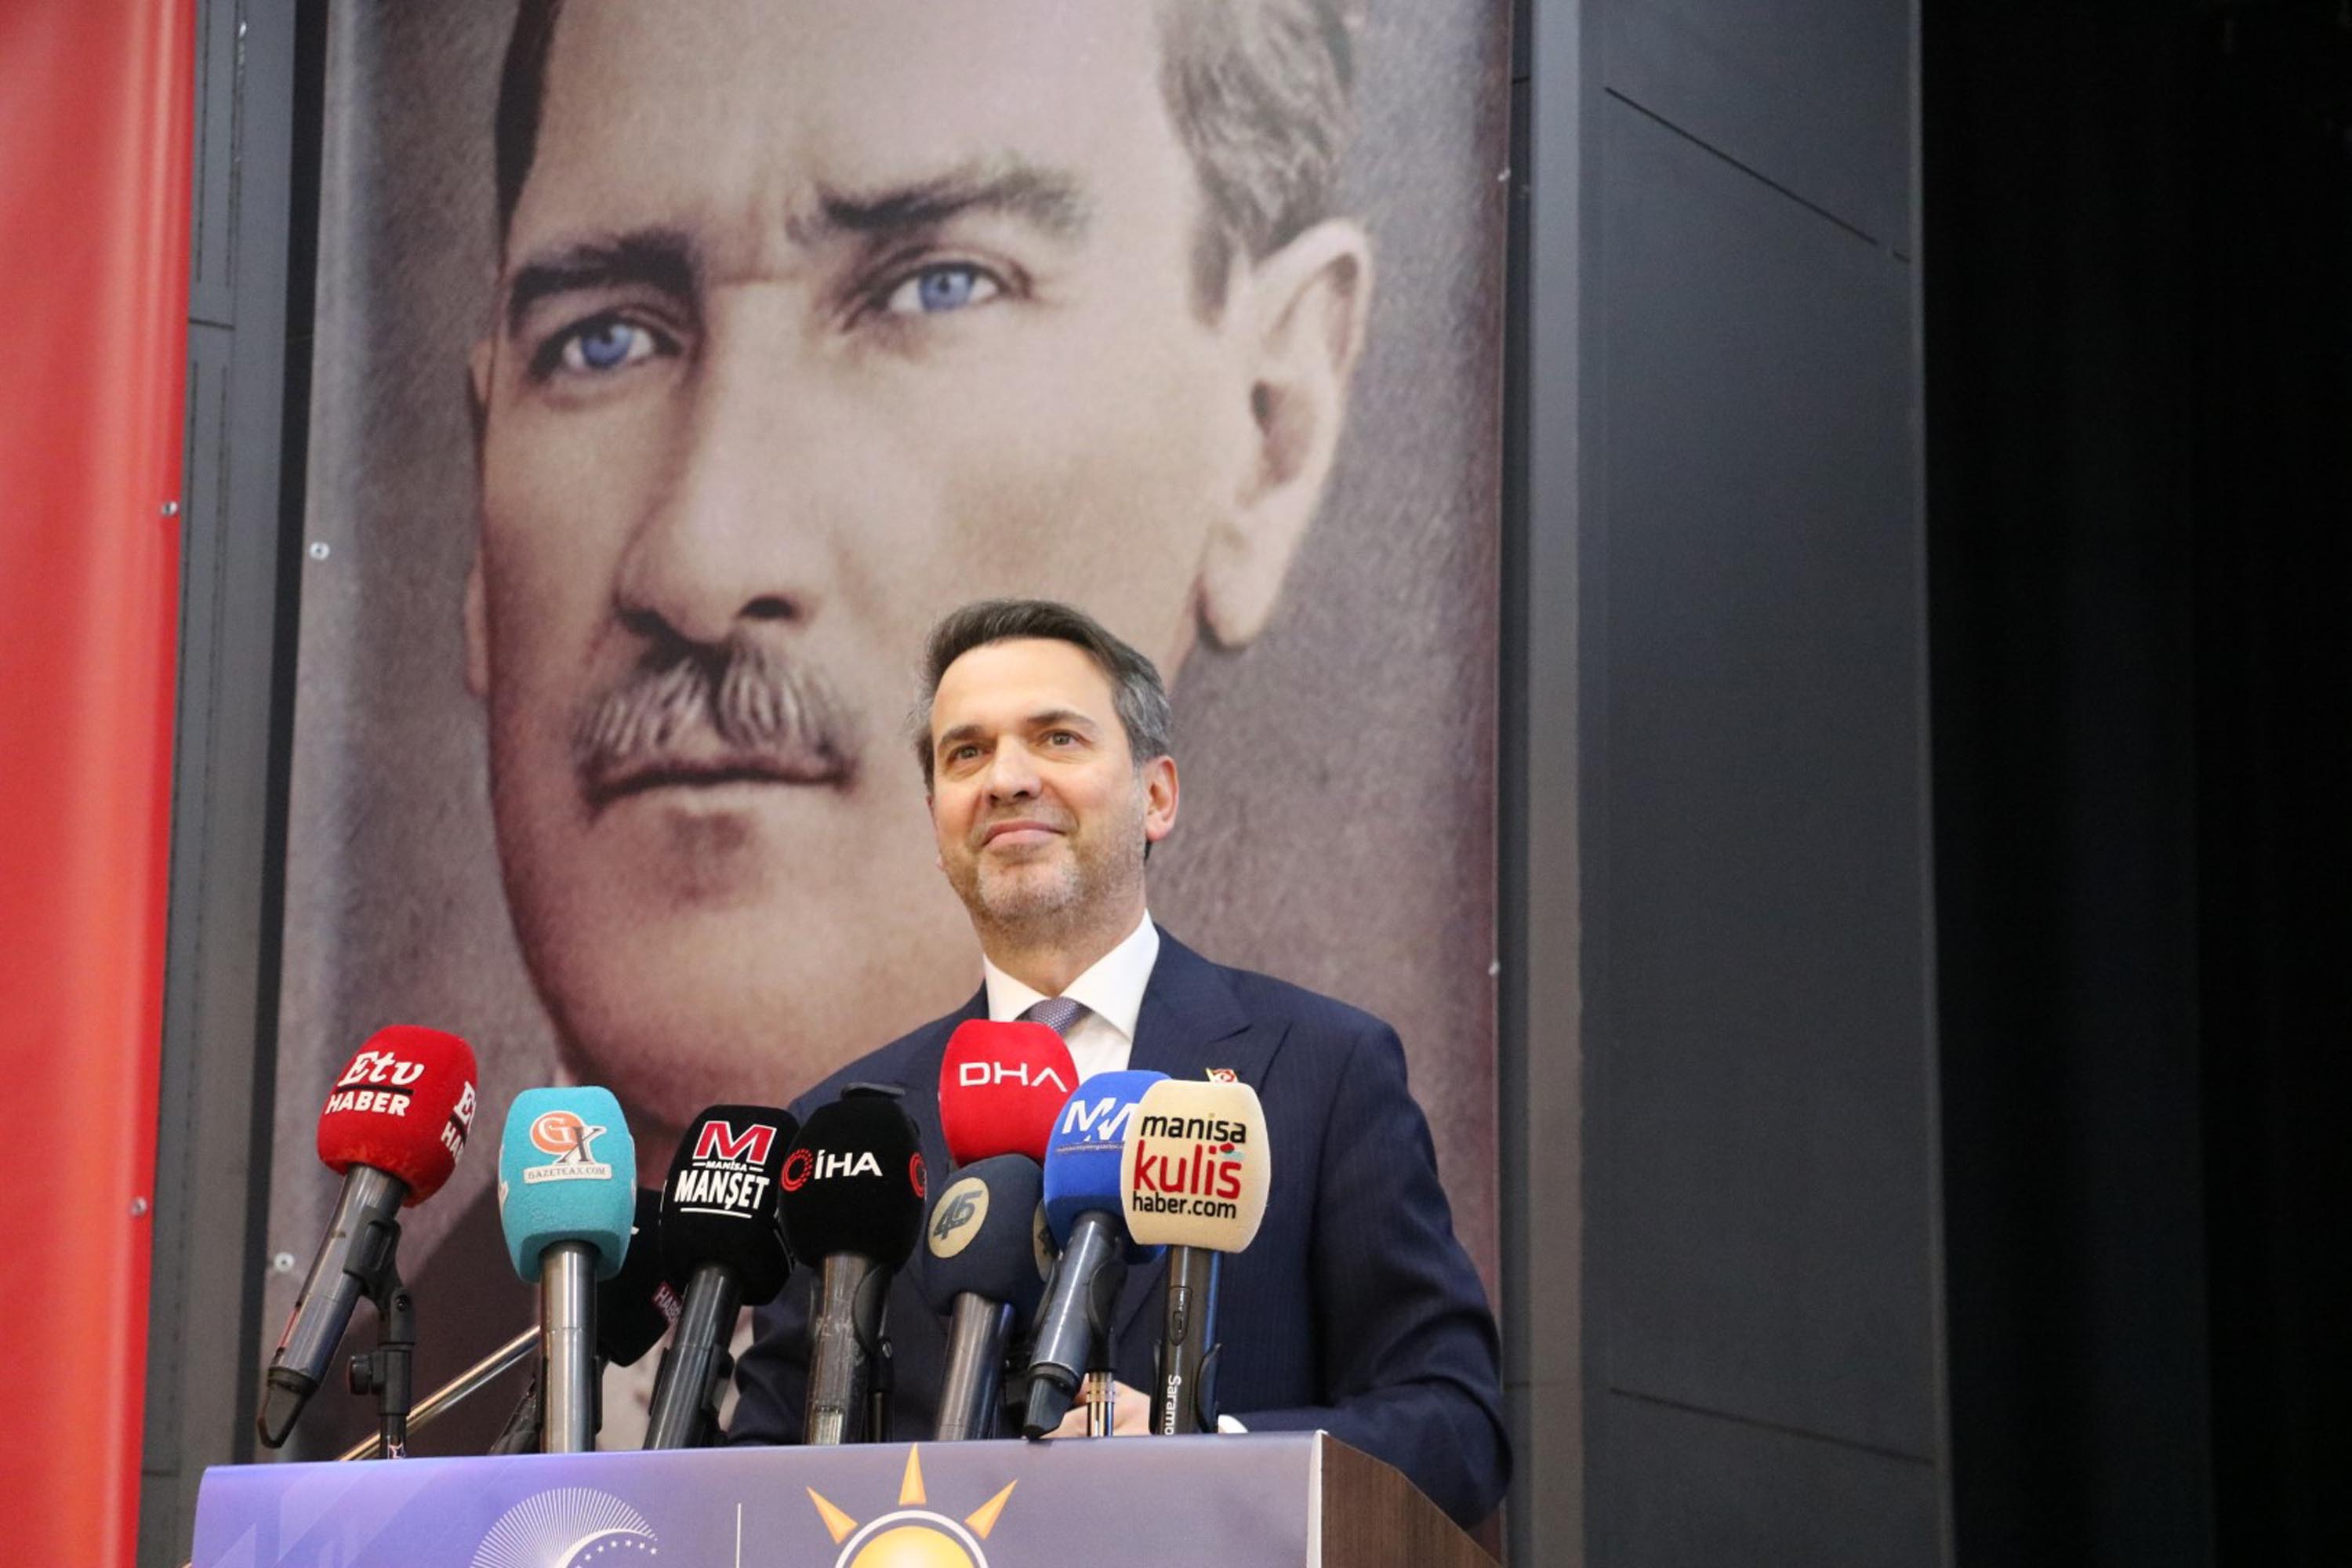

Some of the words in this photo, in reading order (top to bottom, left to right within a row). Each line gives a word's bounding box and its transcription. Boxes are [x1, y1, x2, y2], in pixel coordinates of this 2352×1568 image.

[337, 1051, 425, 1087] Etv
[959, 1062, 1069, 1092] DHA
[325, 1091, 411, 1117] HABER
[692, 1120, 778, 1166] M
[1140, 1112, 1247, 1144] manisa
[528, 1166, 606, 1180] GAZETEAX.COM
[706, 1160, 747, 1172] MANİSA
[814, 1149, 884, 1180] İHA
[1134, 1139, 1242, 1200] kulis
[674, 1170, 771, 1210] MANŞET
[1133, 1190, 1237, 1219] haber.com
